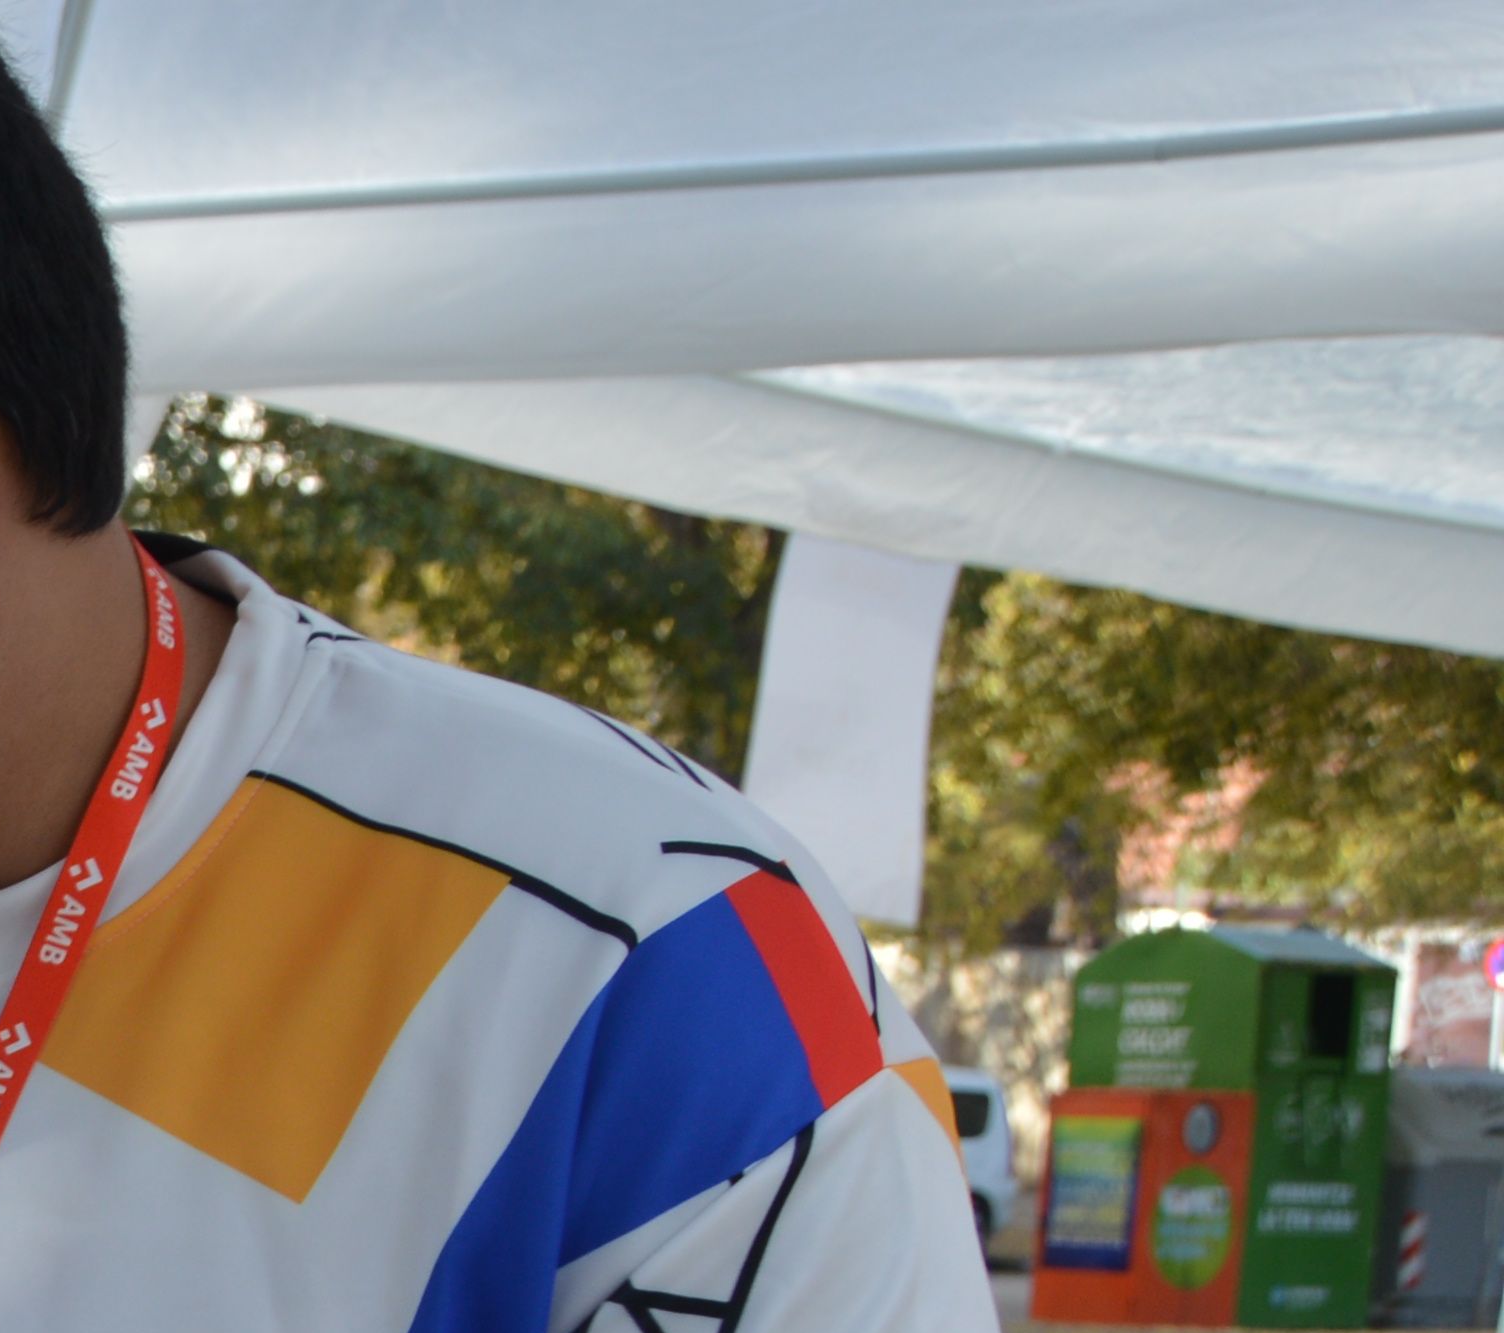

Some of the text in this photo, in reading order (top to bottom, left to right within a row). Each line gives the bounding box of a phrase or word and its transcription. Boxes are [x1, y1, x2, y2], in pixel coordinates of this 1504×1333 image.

[156, 591, 175, 649] AMB
[110, 731, 155, 801] AMB
[39, 894, 86, 966] AMB
